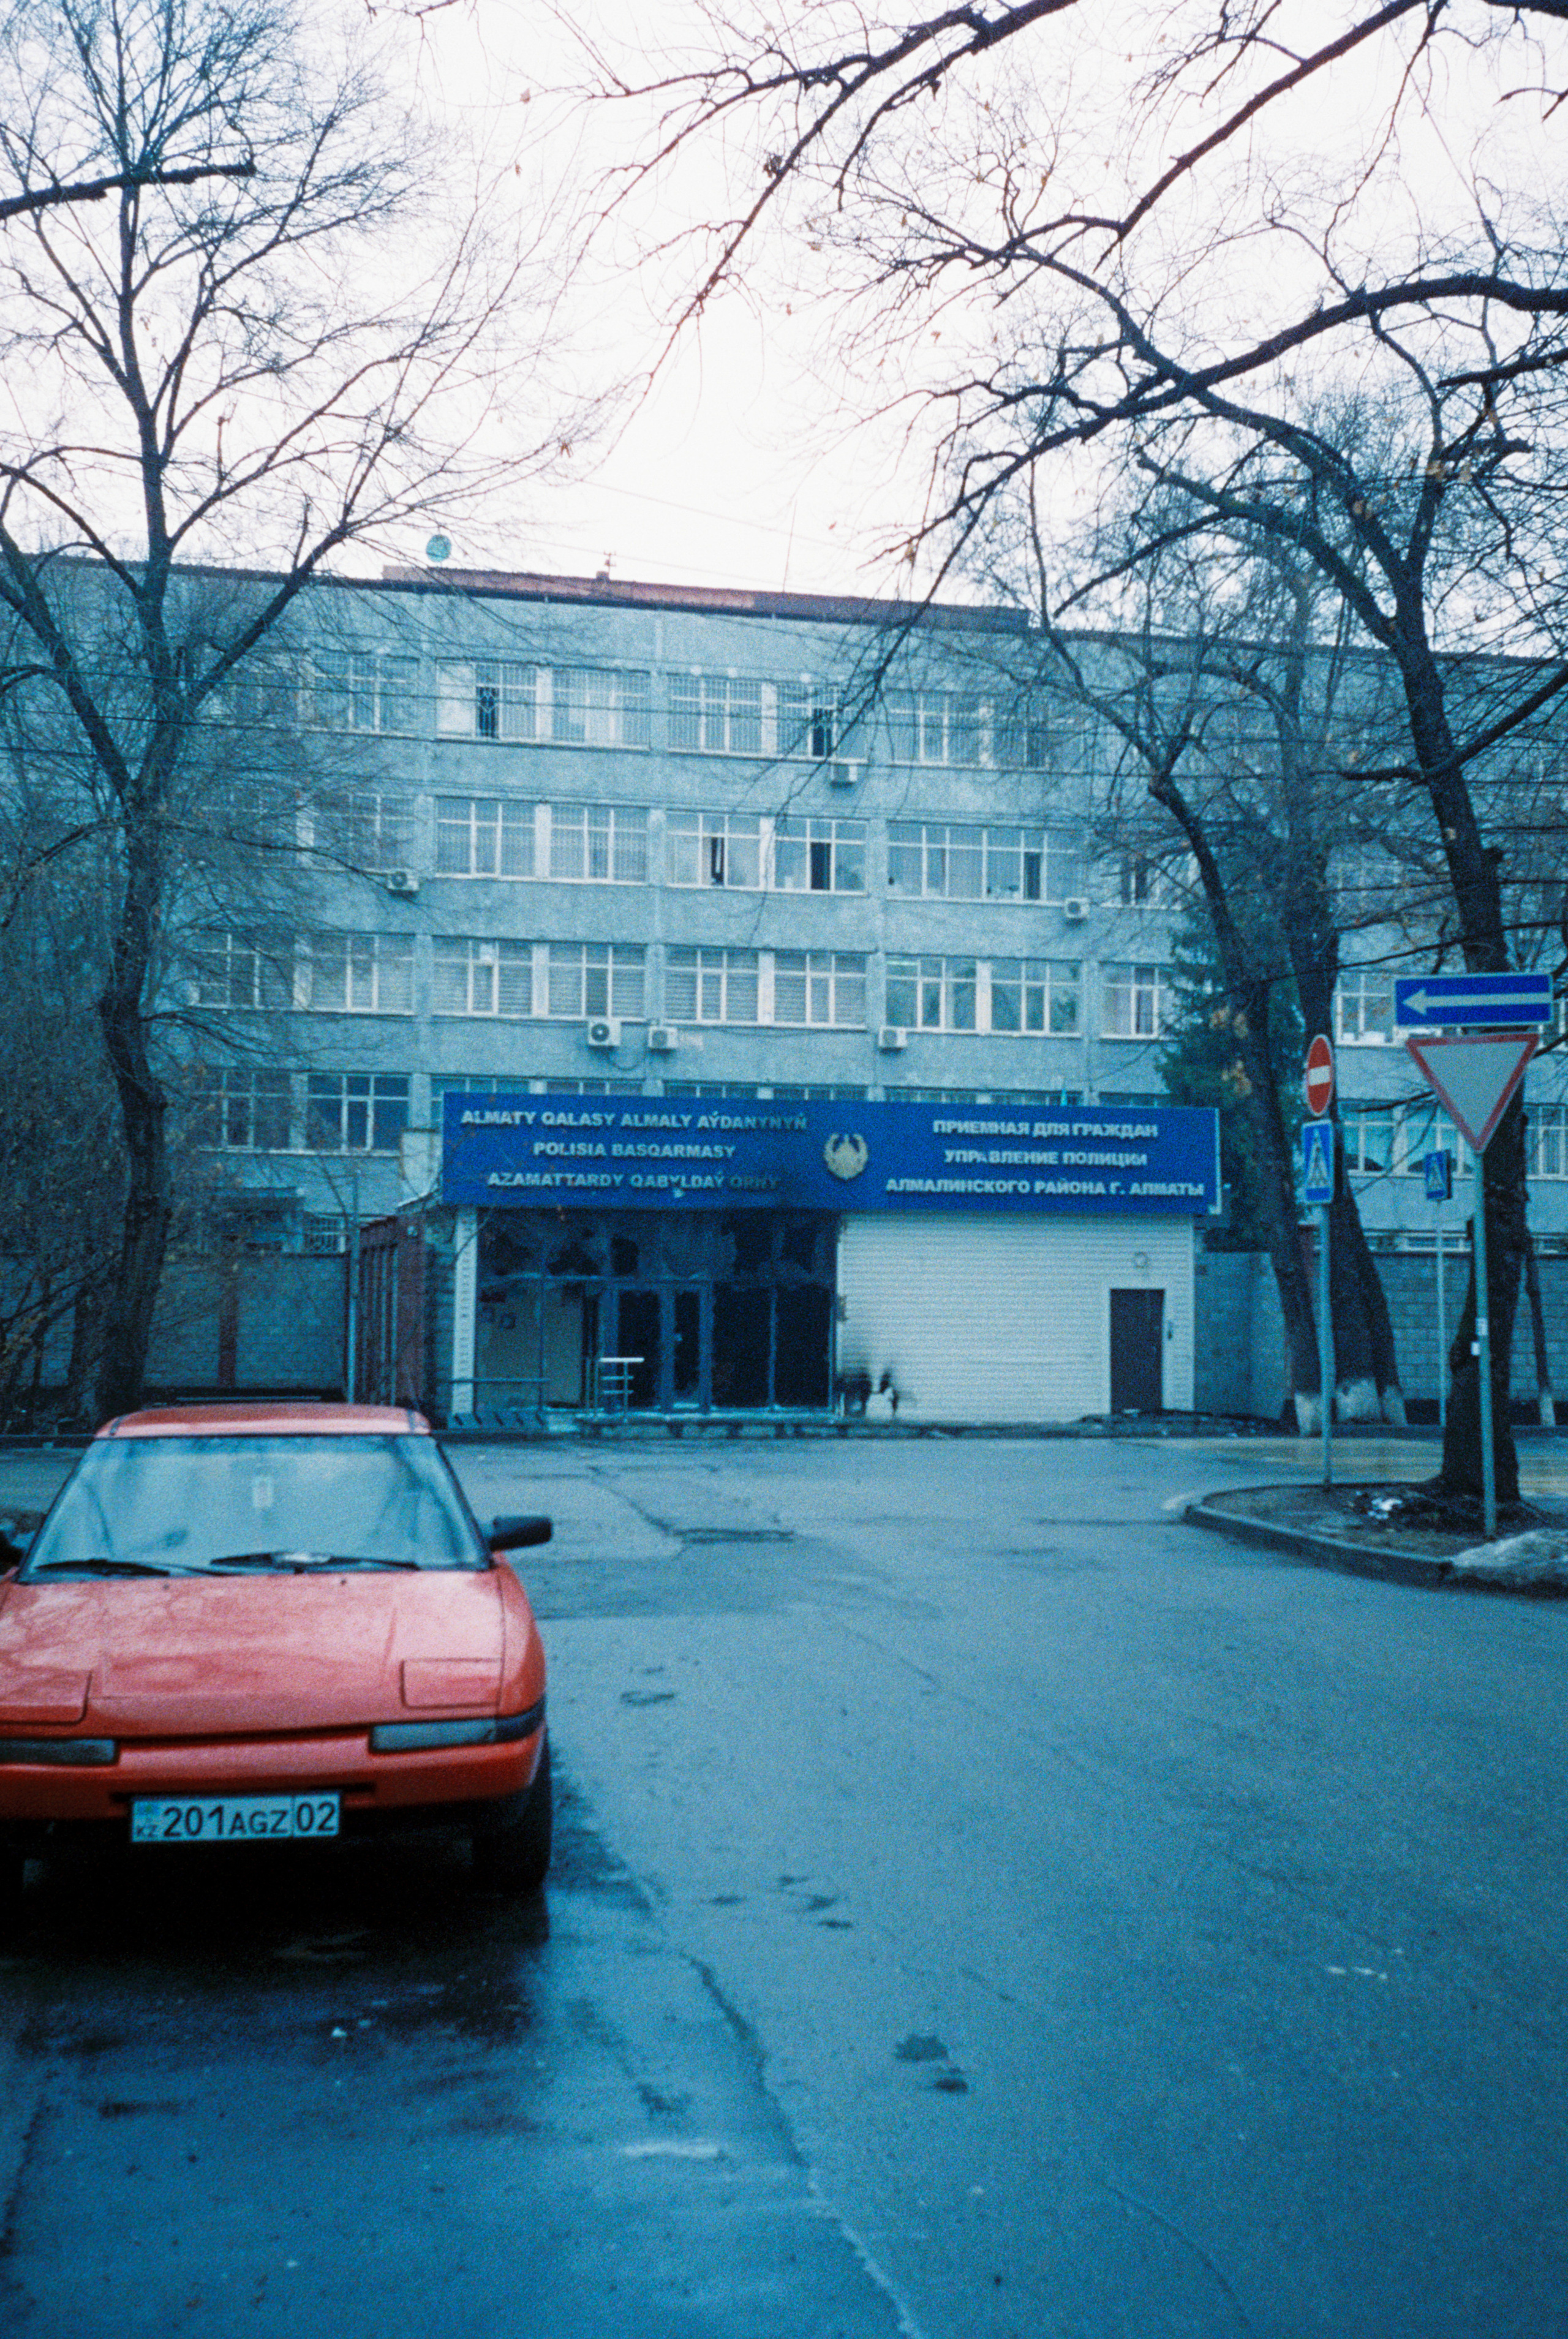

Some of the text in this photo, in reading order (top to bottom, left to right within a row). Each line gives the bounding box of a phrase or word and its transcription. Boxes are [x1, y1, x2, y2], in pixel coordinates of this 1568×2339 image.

[461, 1110, 537, 1124] ALMATY
[541, 1111, 616, 1126] QALASY
[620, 1113, 693, 1128] ALMALY
[933, 1120, 1158, 1140] ПРИЕМНАЯ ДЛЯ ГРАЖДАН
[533, 1142, 736, 1158] POLISIA BASQARMASY
[1063, 1151, 1147, 1168] ПОЛИЦИИ
[488, 1172, 624, 1187] AZAMATTARDY
[886, 1177, 1204, 1196] АЛМАЛИНСКОГО РАЙОНА Г. АЛМАТЫ
[296, 1801, 336, 1832] 02
